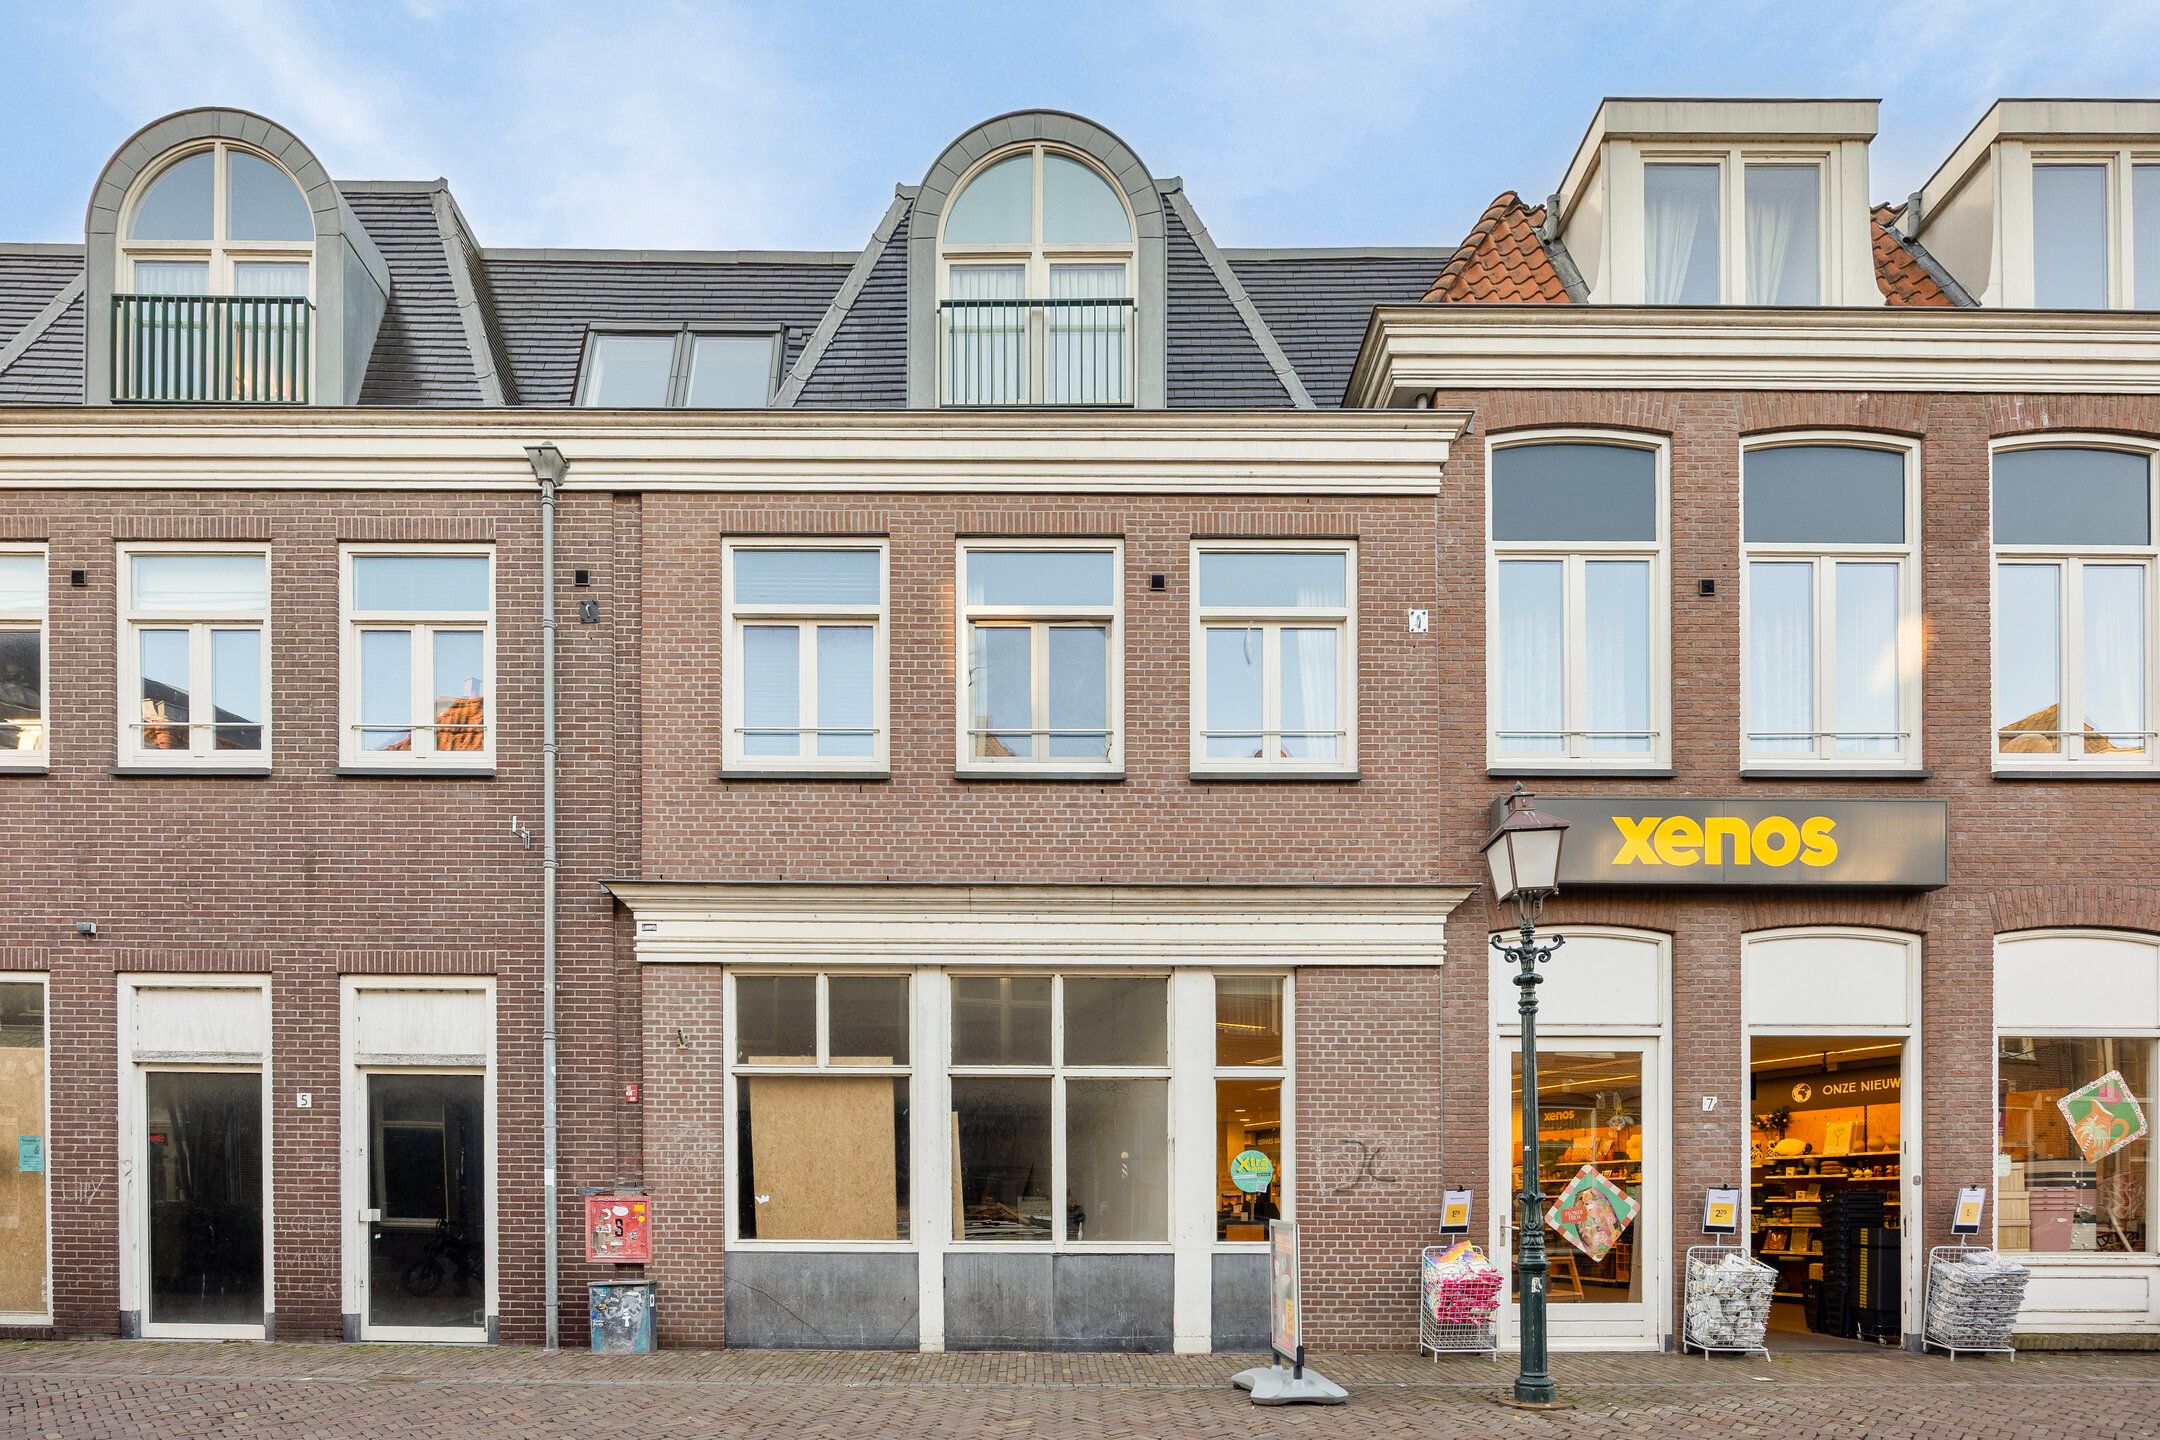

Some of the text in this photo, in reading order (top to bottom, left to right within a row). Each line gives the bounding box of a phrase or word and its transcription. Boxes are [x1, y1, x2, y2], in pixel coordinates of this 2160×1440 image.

[1611, 815, 1839, 867] xenos
[1822, 1077, 1900, 1095] ONZE NIEUW
[301, 1094, 308, 1106] 5
[1706, 1097, 1714, 1110] 7
[1543, 1109, 1575, 1121] xenos
[1236, 1155, 1269, 1173] Xtra
